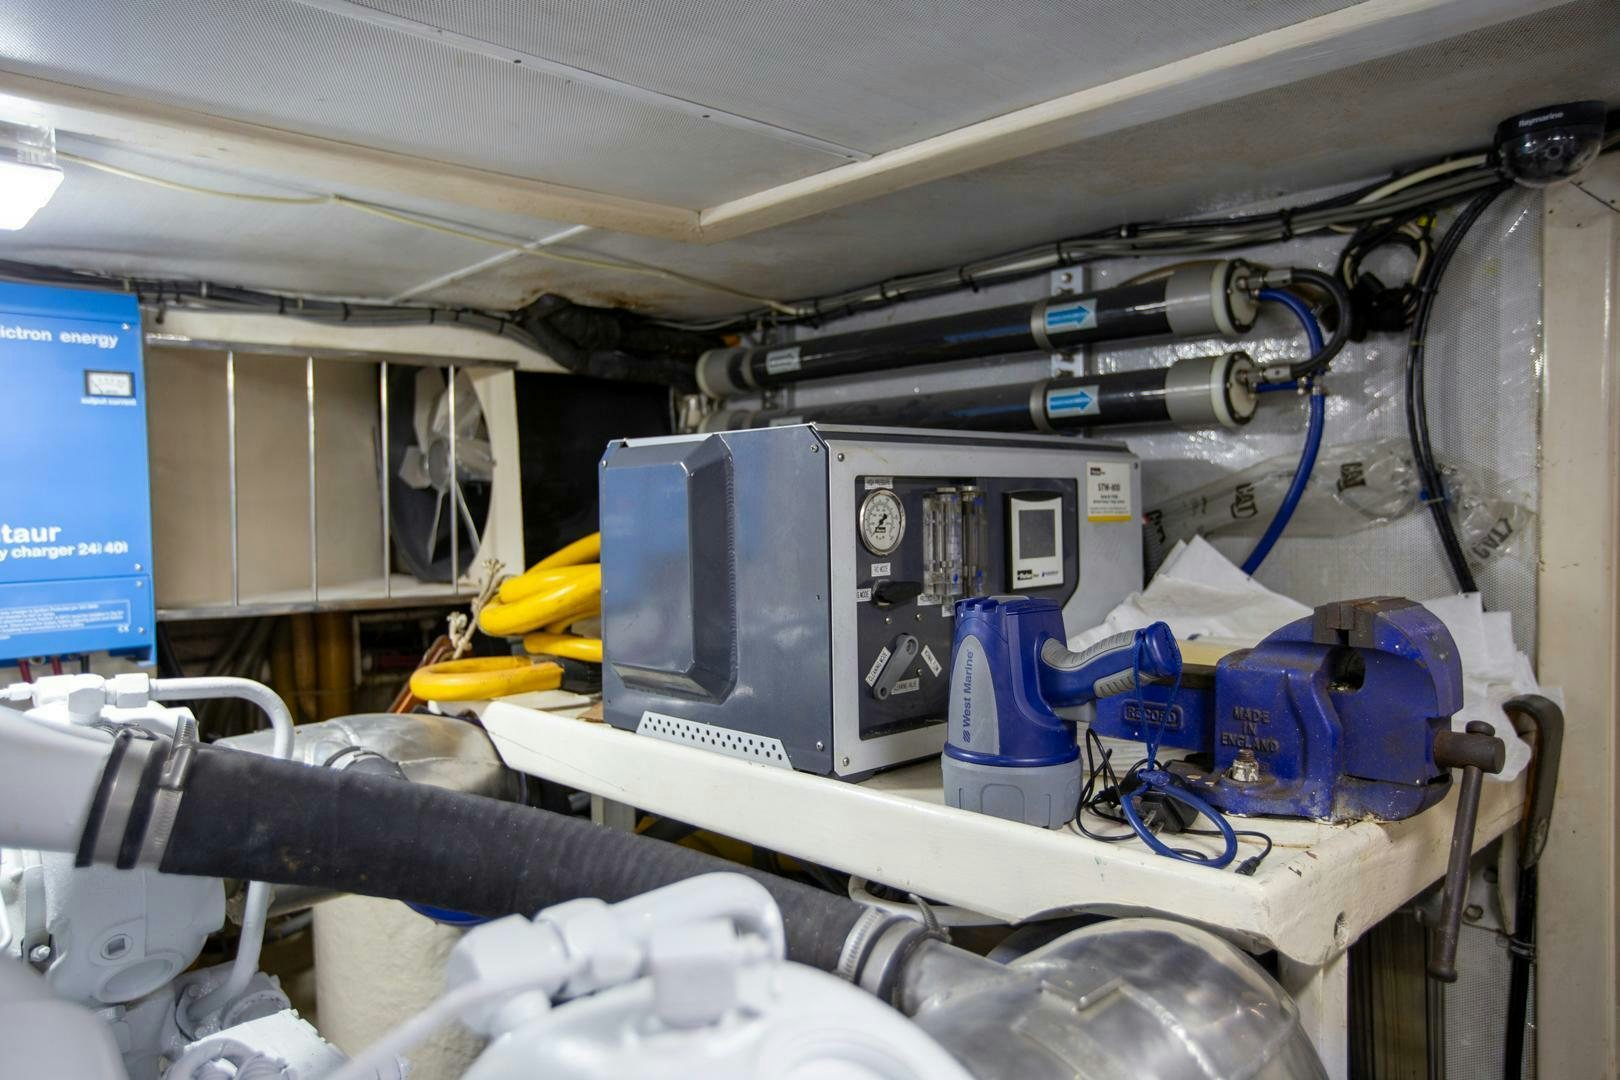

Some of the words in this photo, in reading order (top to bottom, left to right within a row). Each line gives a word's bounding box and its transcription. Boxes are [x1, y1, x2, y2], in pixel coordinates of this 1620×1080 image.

[59, 331, 119, 349] energy
[11, 545, 75, 560] charger
[964, 650, 974, 694] Marine
[963, 697, 971, 728] West
[1232, 706, 1271, 724] MADE
[1243, 720, 1257, 737] IN
[1221, 732, 1281, 752] ENGLAND
